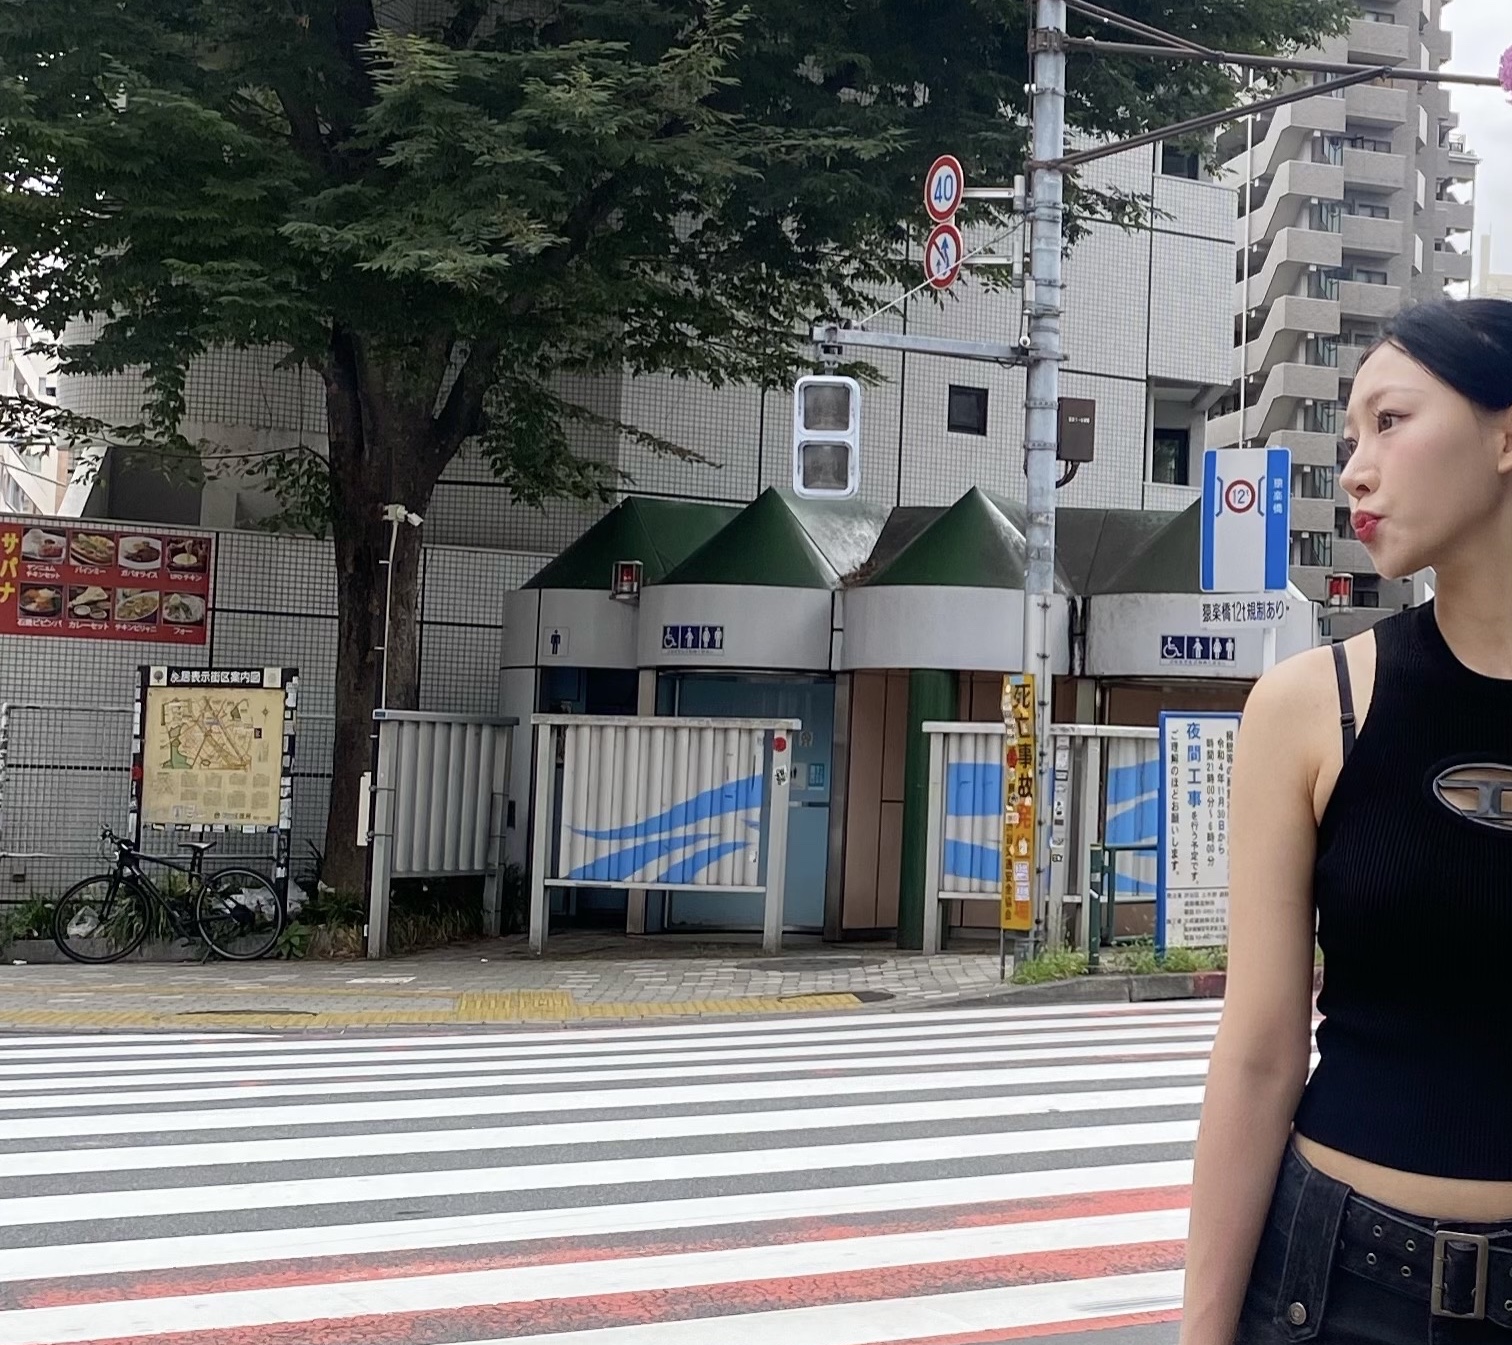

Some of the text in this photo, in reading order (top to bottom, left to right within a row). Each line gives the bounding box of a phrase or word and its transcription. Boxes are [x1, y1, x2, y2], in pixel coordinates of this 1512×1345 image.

[934, 174, 954, 204] 40
[0, 532, 20, 603] サパナ
